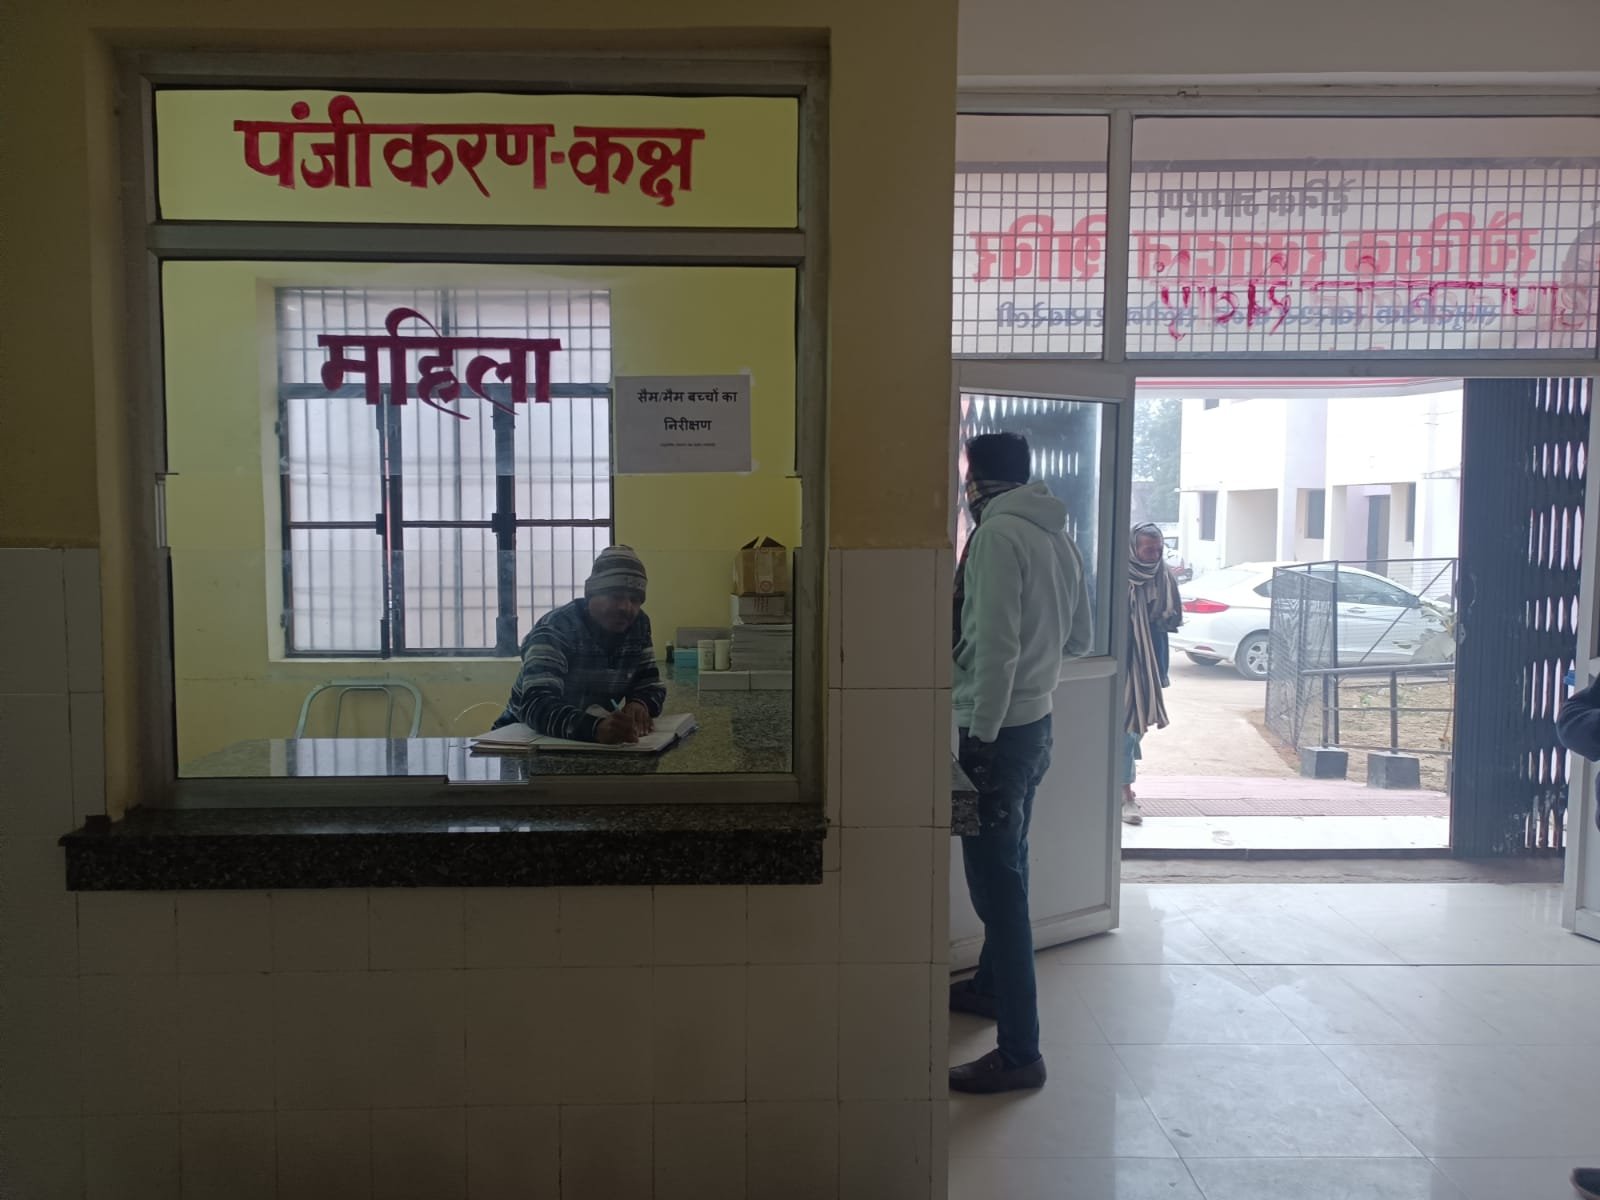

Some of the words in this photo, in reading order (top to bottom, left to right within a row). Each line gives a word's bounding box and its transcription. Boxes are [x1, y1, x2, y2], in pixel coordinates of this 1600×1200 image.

[233, 95, 706, 207] पंजीकरण-कक्ष
[317, 307, 563, 420] महिला
[687, 388, 720, 402] बच्चों
[721, 391, 738, 402] का
[663, 416, 713, 432] निरीक्षण
